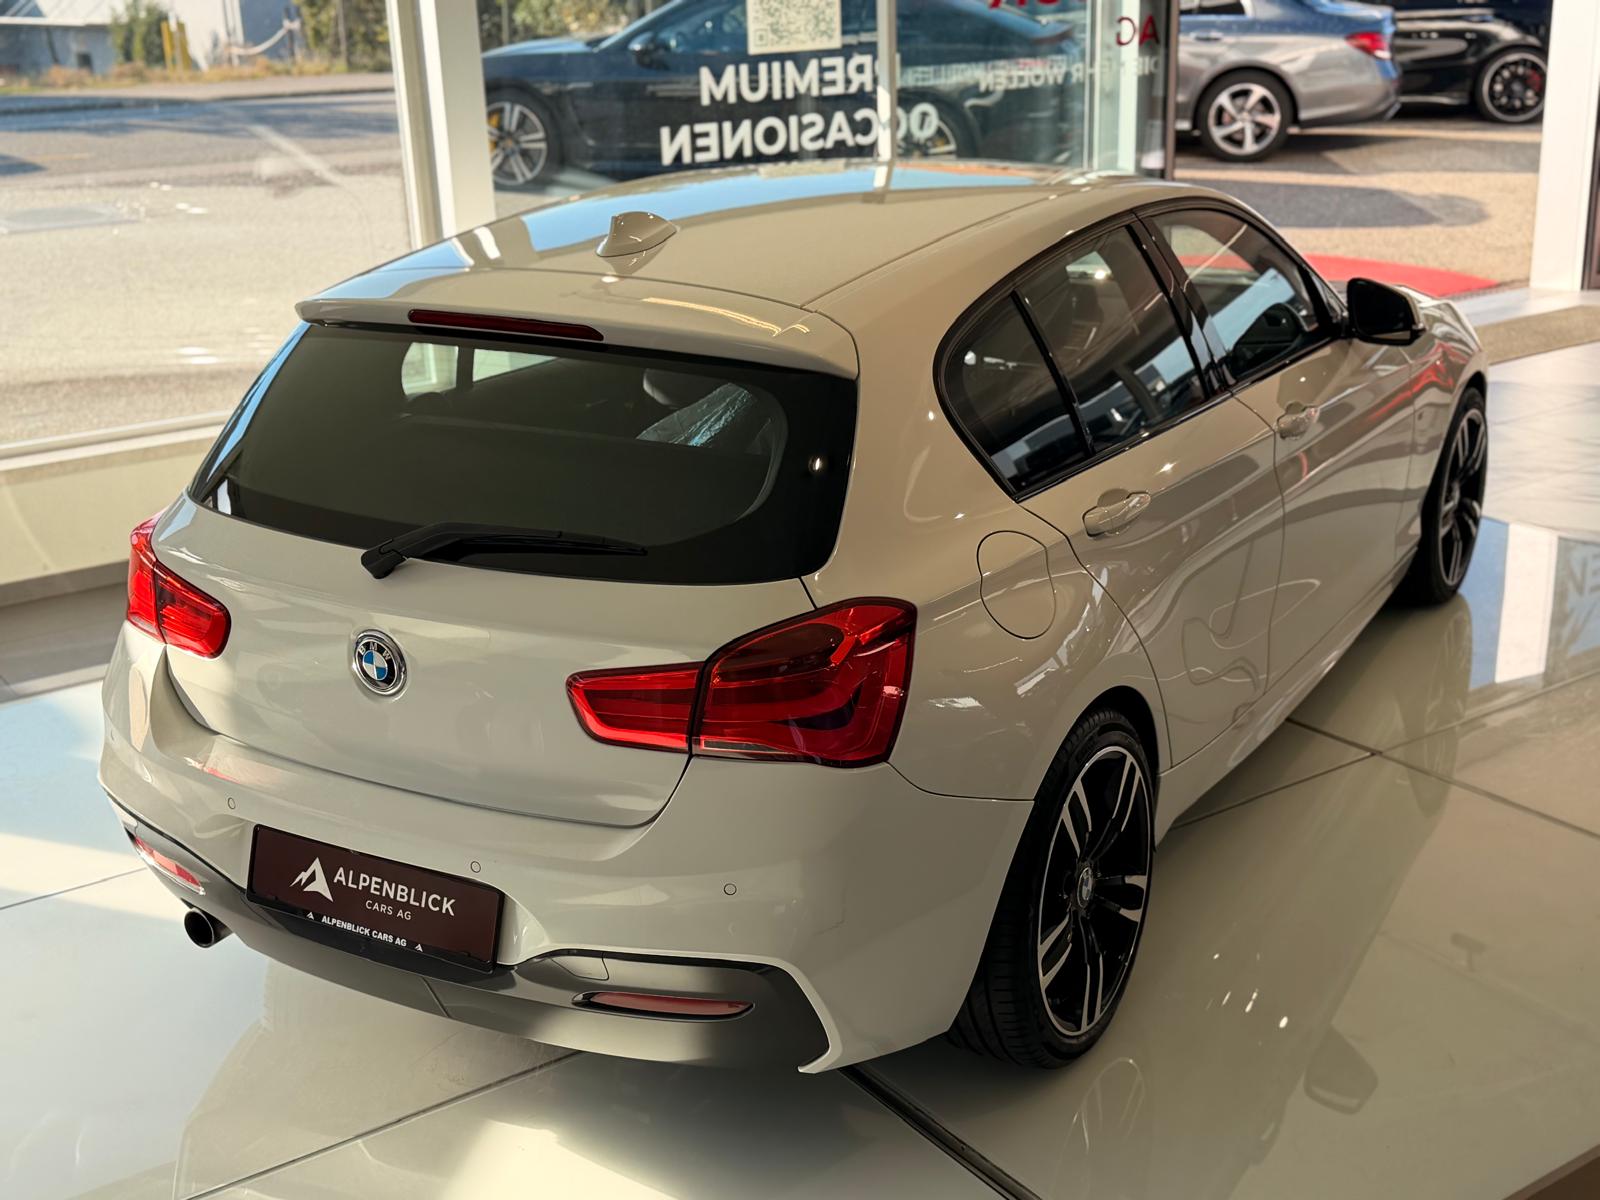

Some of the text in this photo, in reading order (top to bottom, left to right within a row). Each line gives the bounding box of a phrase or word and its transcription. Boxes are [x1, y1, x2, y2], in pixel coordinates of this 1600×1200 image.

[358, 640, 392, 661] BMW
[333, 866, 456, 917] ALPENBLICK
[365, 900, 412, 921] CARS AG
[321, 915, 407, 947] ALPENBLICK CARS AG
